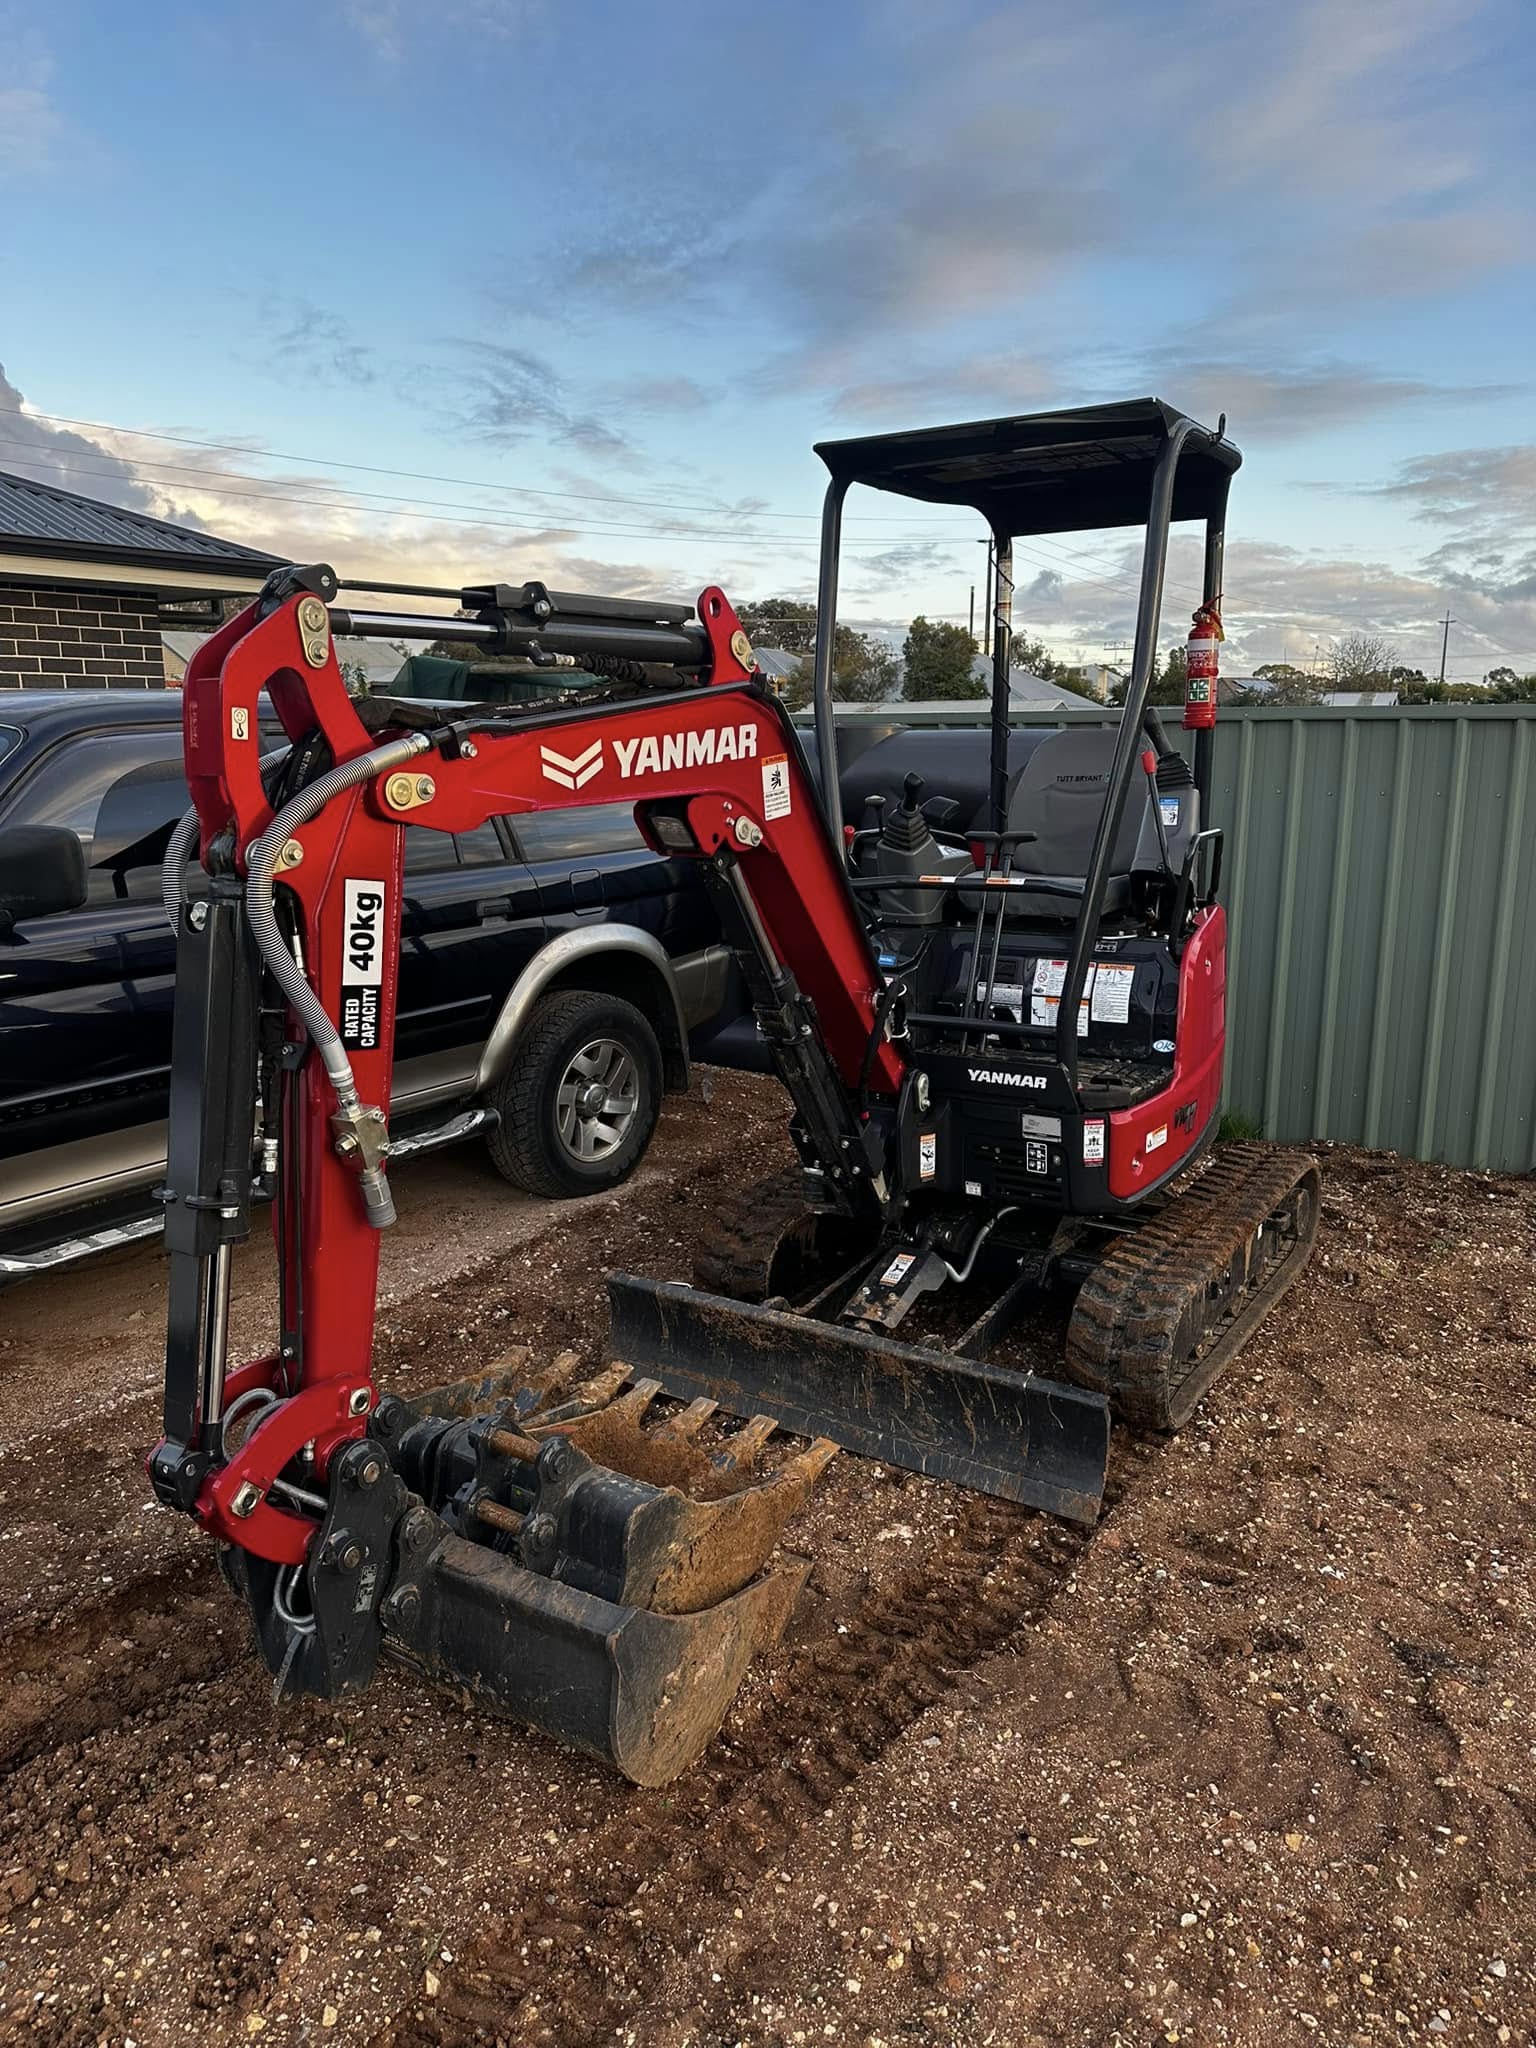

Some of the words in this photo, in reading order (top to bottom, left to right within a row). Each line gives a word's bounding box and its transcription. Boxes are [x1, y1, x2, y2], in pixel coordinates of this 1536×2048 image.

[612, 723, 758, 779] YANMAR
[1075, 774, 1103, 783] BRYANT
[349, 892, 383, 972] 40kg
[344, 998, 360, 1037] RATED
[361, 988, 377, 1047] CAPACITY
[967, 1068, 1048, 1089] YANMAR
